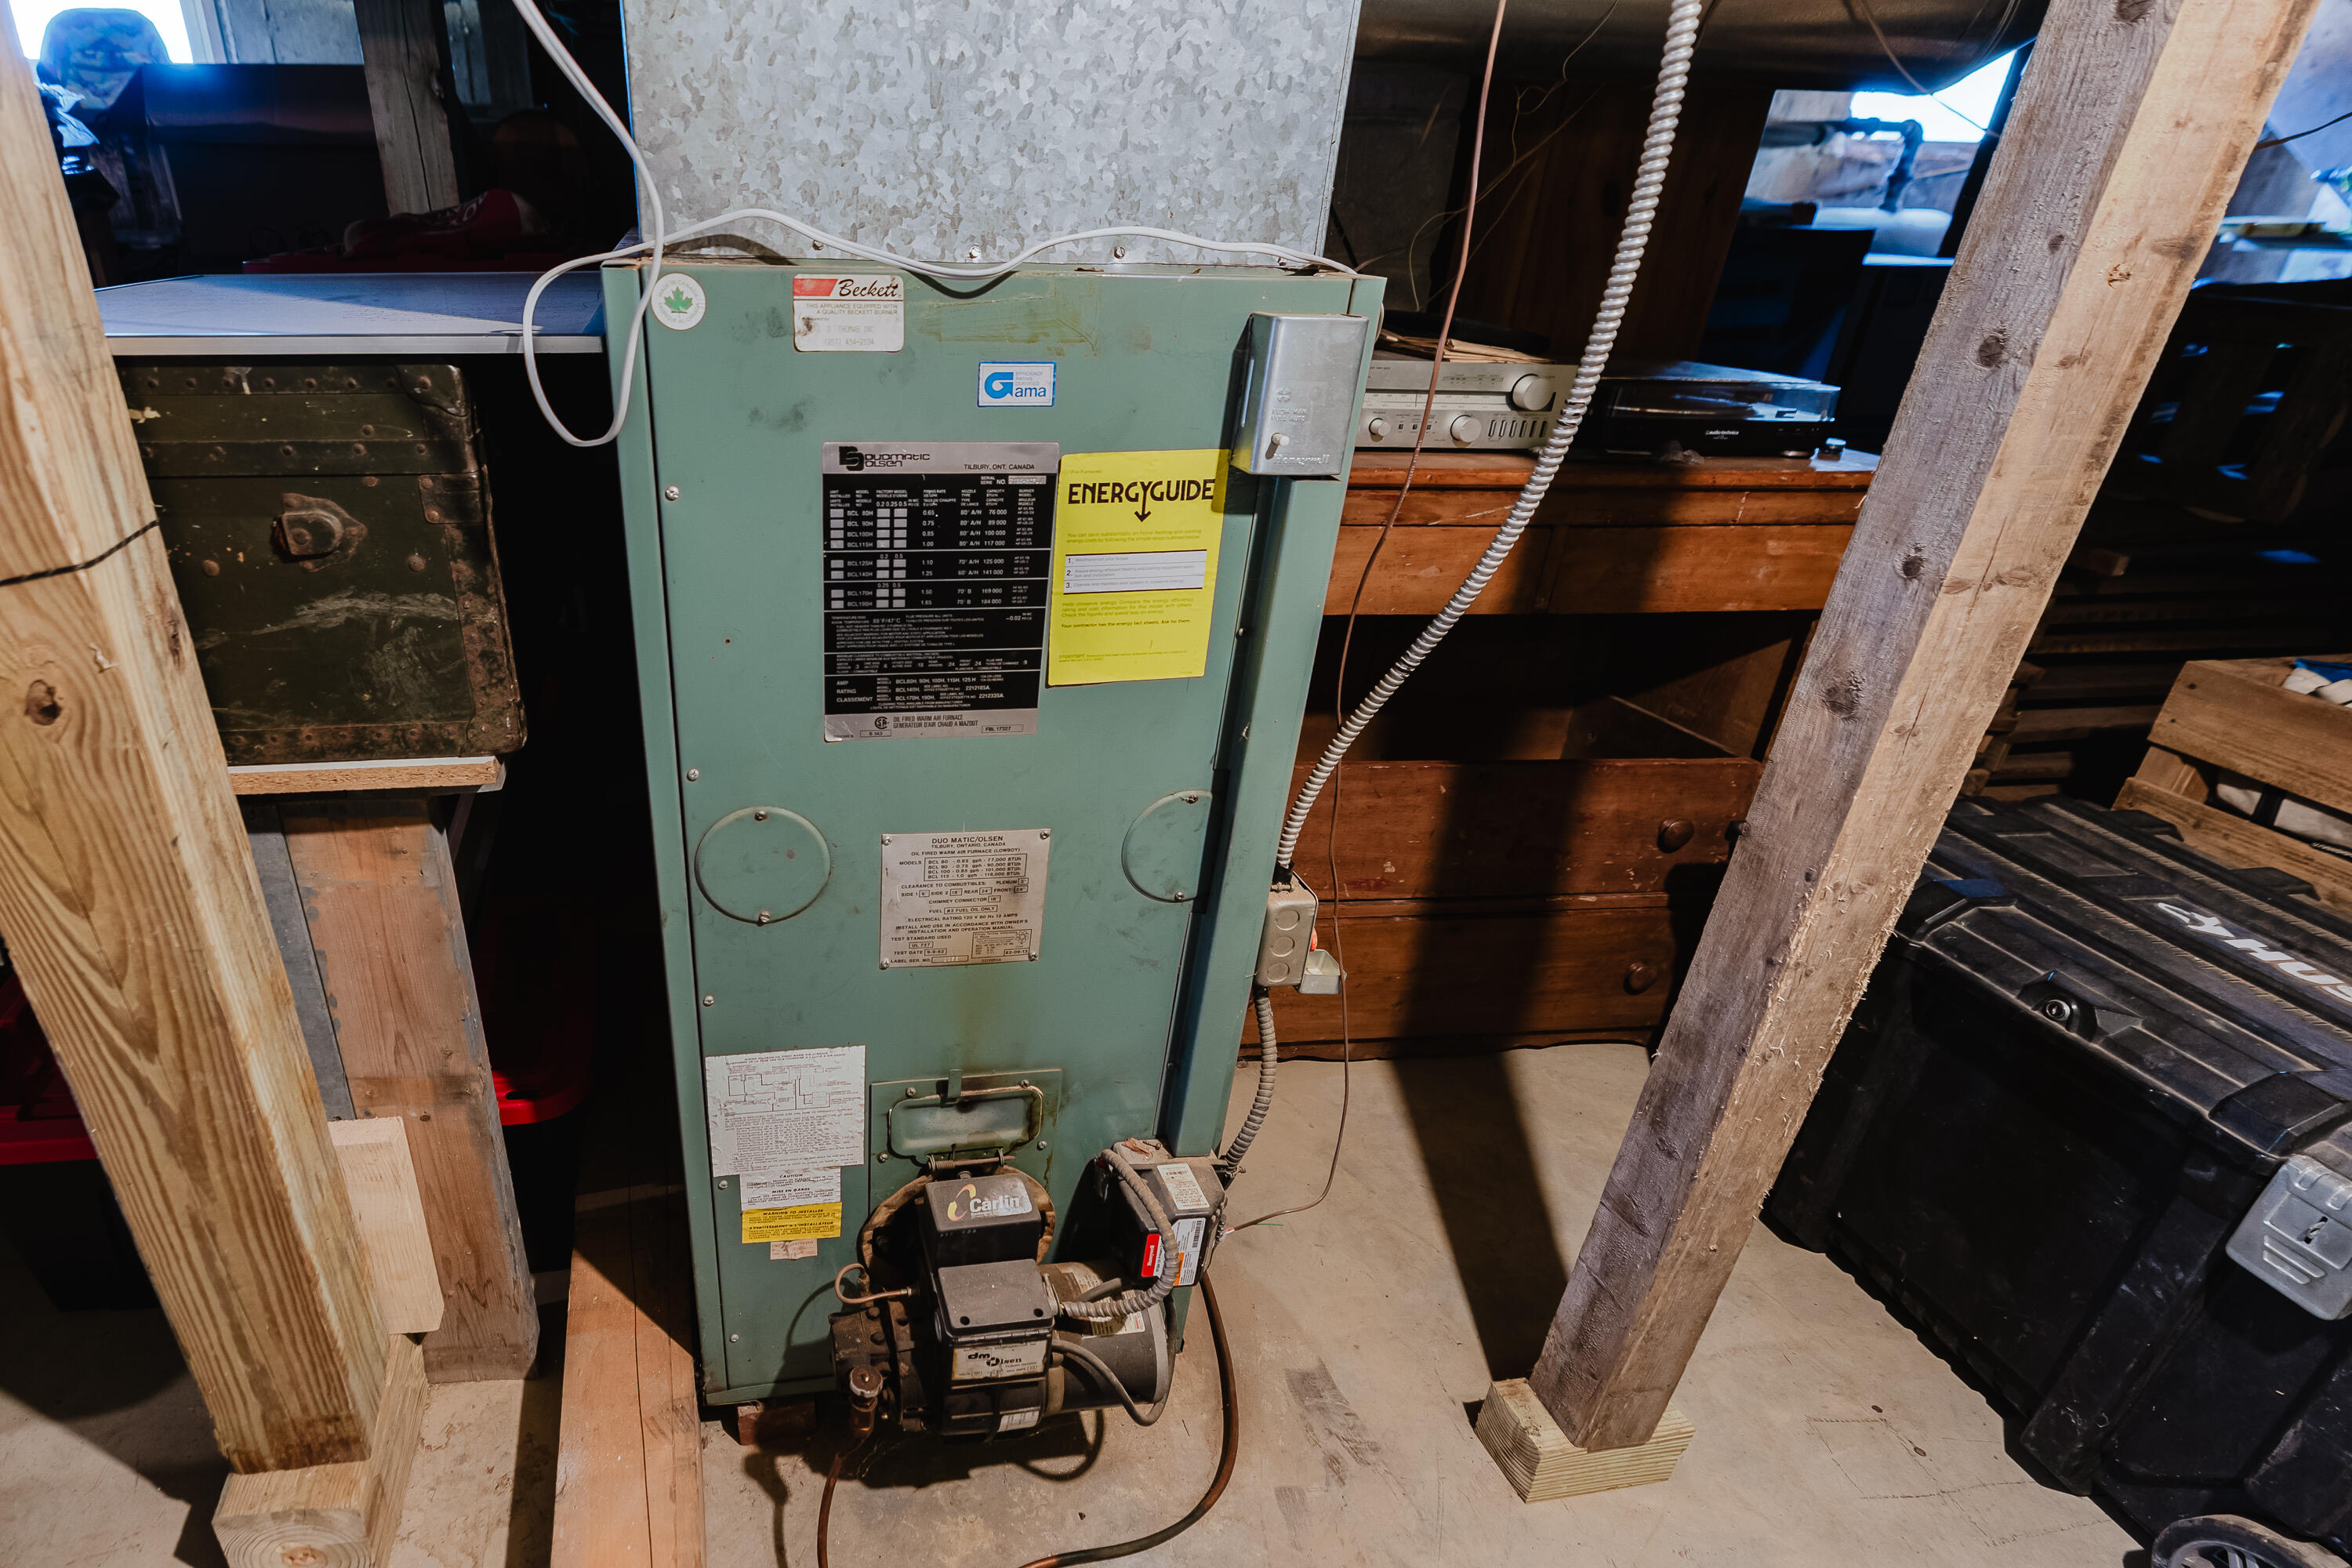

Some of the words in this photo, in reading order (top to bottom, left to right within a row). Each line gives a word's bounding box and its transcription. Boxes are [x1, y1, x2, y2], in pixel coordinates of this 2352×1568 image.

[838, 278, 898, 297] Beckett
[1067, 479, 1215, 507] ENERGYGUIDE
[970, 1195, 1019, 1213] Carlin
